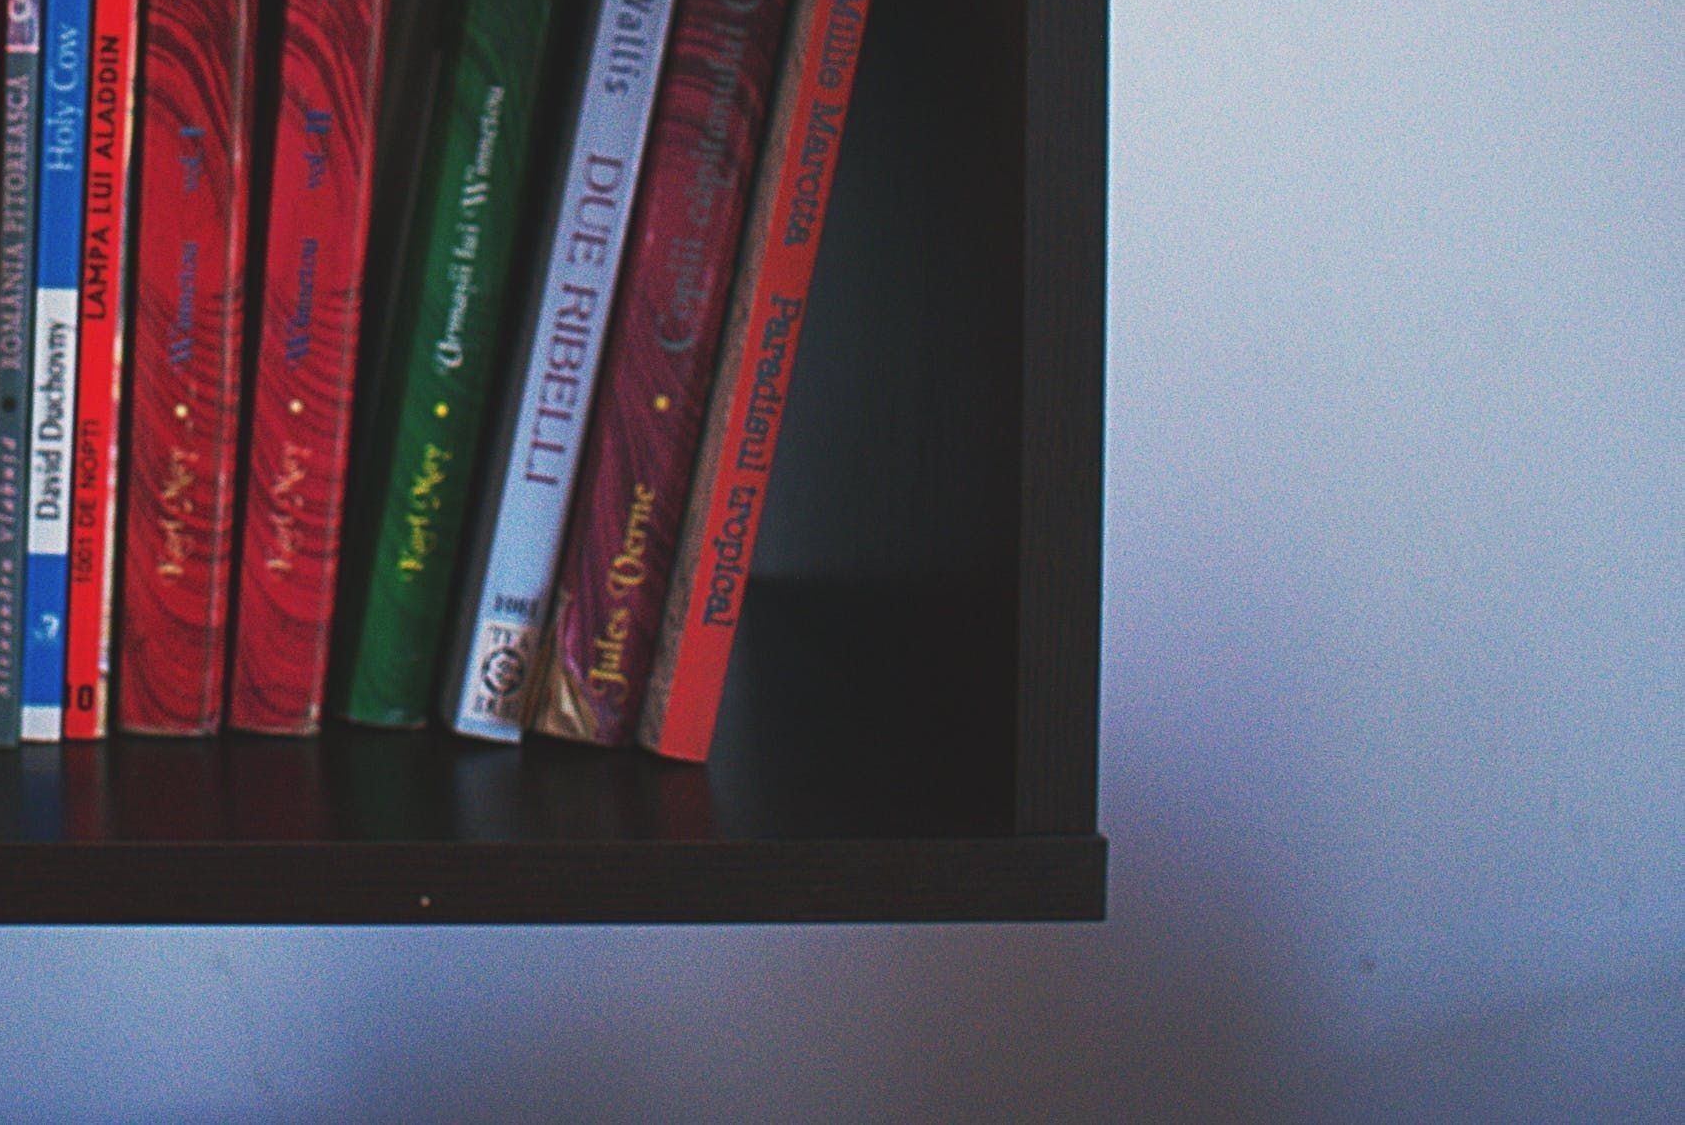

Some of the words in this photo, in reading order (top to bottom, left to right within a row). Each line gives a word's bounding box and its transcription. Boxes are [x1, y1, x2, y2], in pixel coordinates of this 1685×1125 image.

[48, 20, 79, 92] Cow
[93, 33, 120, 161] ALADDIN
[43, 99, 84, 171] Holy
[783, 101, 844, 247] Marotta
[90, 172, 114, 215] LUI
[564, 152, 623, 268] DUE
[87, 225, 113, 321] LAMPA
[37, 318, 67, 442] Duchovny
[523, 282, 598, 486] RIBELLI
[736, 294, 803, 473] Paradisul
[34, 449, 62, 522] David
[76, 496, 96, 529] DE
[605, 482, 657, 598] Verne
[702, 485, 759, 628] tropical
[587, 608, 631, 705] Jules
